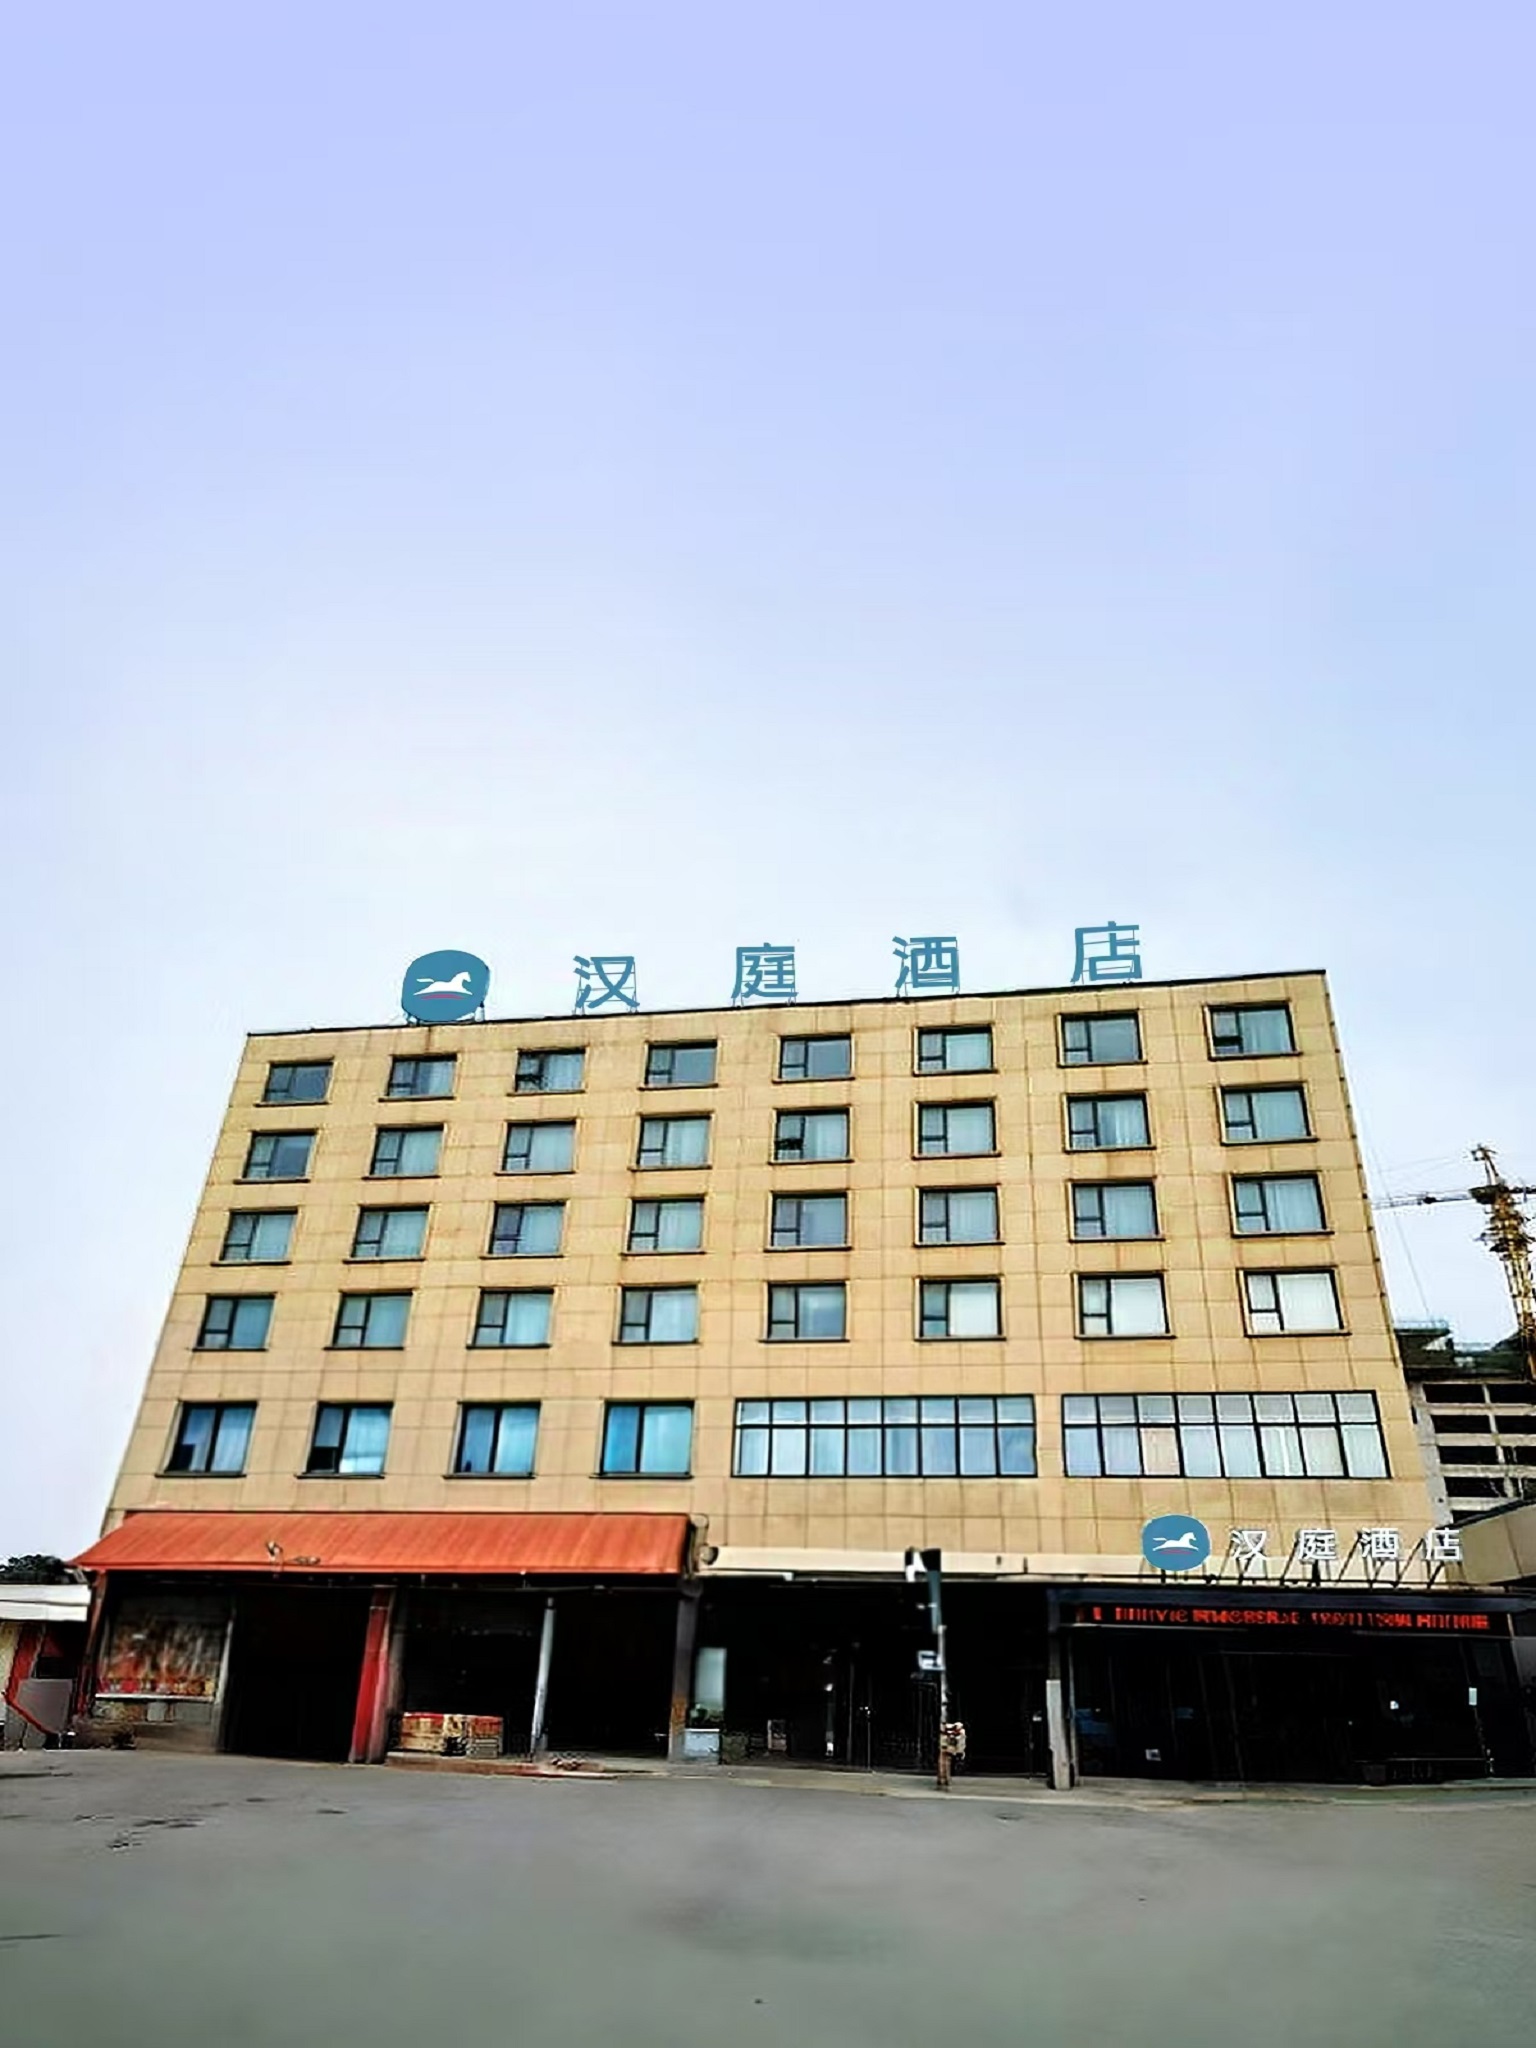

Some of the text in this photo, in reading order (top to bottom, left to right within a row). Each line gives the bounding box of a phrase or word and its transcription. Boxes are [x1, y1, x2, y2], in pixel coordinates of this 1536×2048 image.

[573, 921, 1143, 1009] 汉庭酒店
[1230, 1527, 1462, 1561] 汉庭酒店
